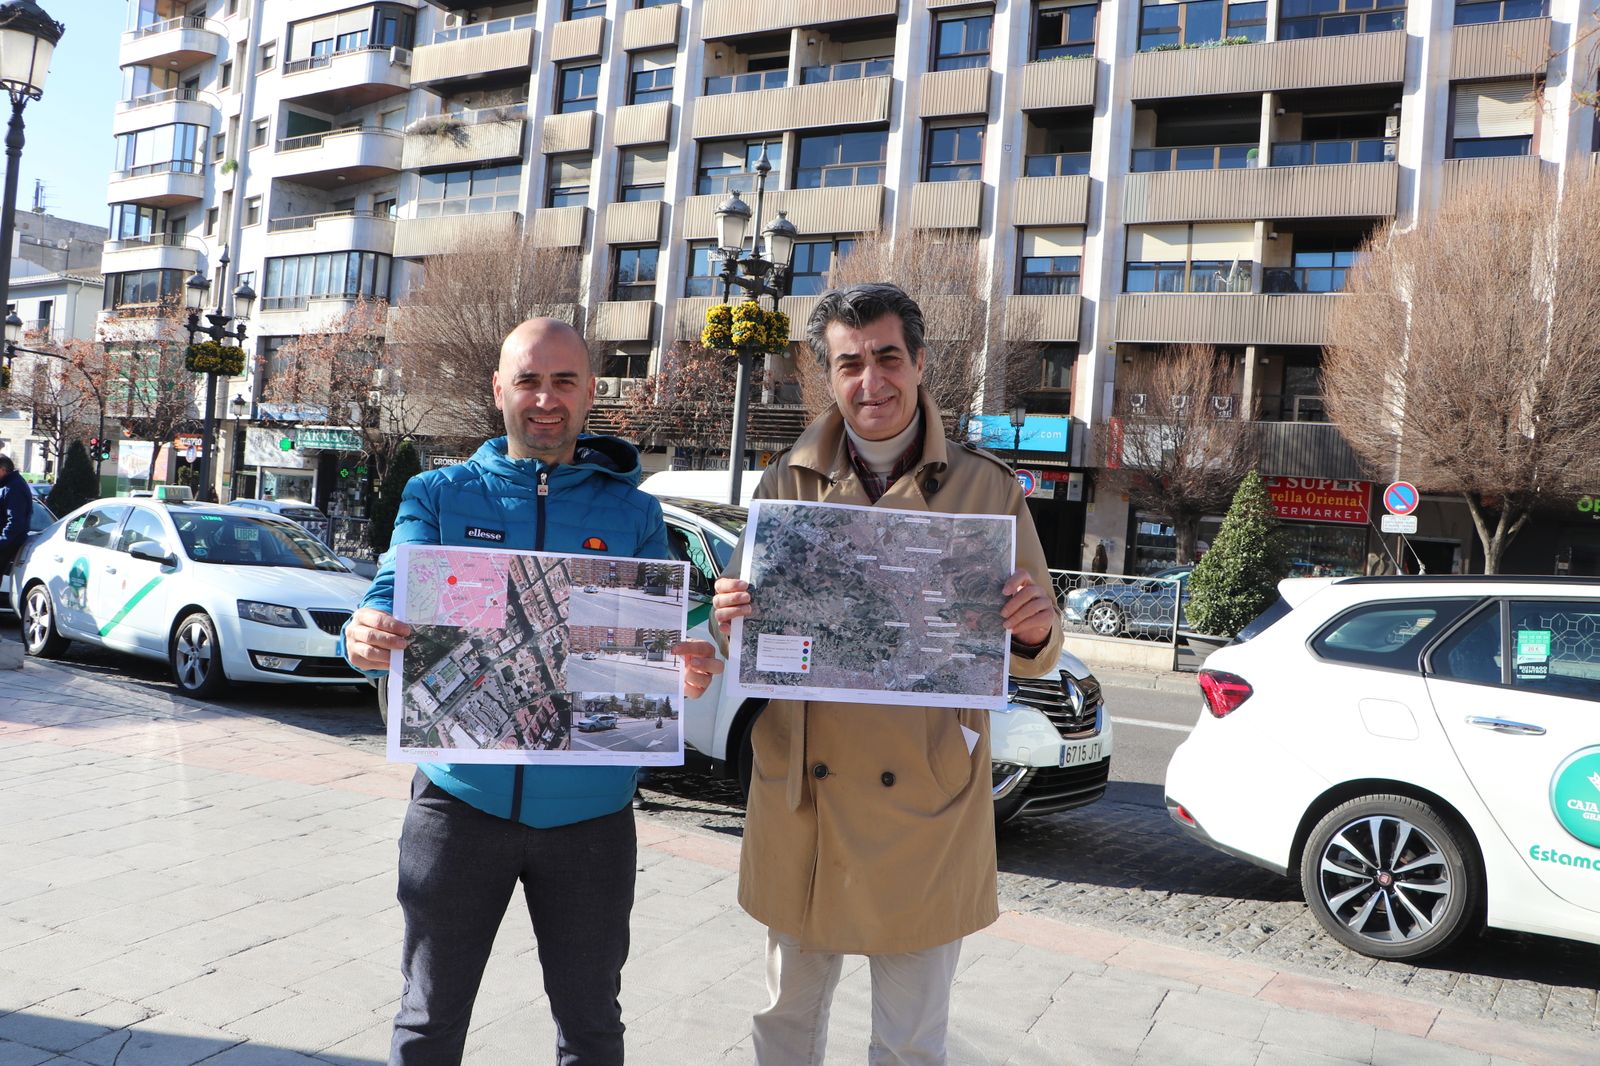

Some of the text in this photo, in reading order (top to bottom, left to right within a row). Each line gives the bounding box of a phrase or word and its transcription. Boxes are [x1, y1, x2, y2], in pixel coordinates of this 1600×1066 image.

[1286, 477, 1363, 492] SUPER
[1306, 491, 1362, 507] Oriental
[236, 529, 258, 540] LIBRE
[468, 528, 502, 540] ellesse
[1066, 744, 1087, 763] 6715
